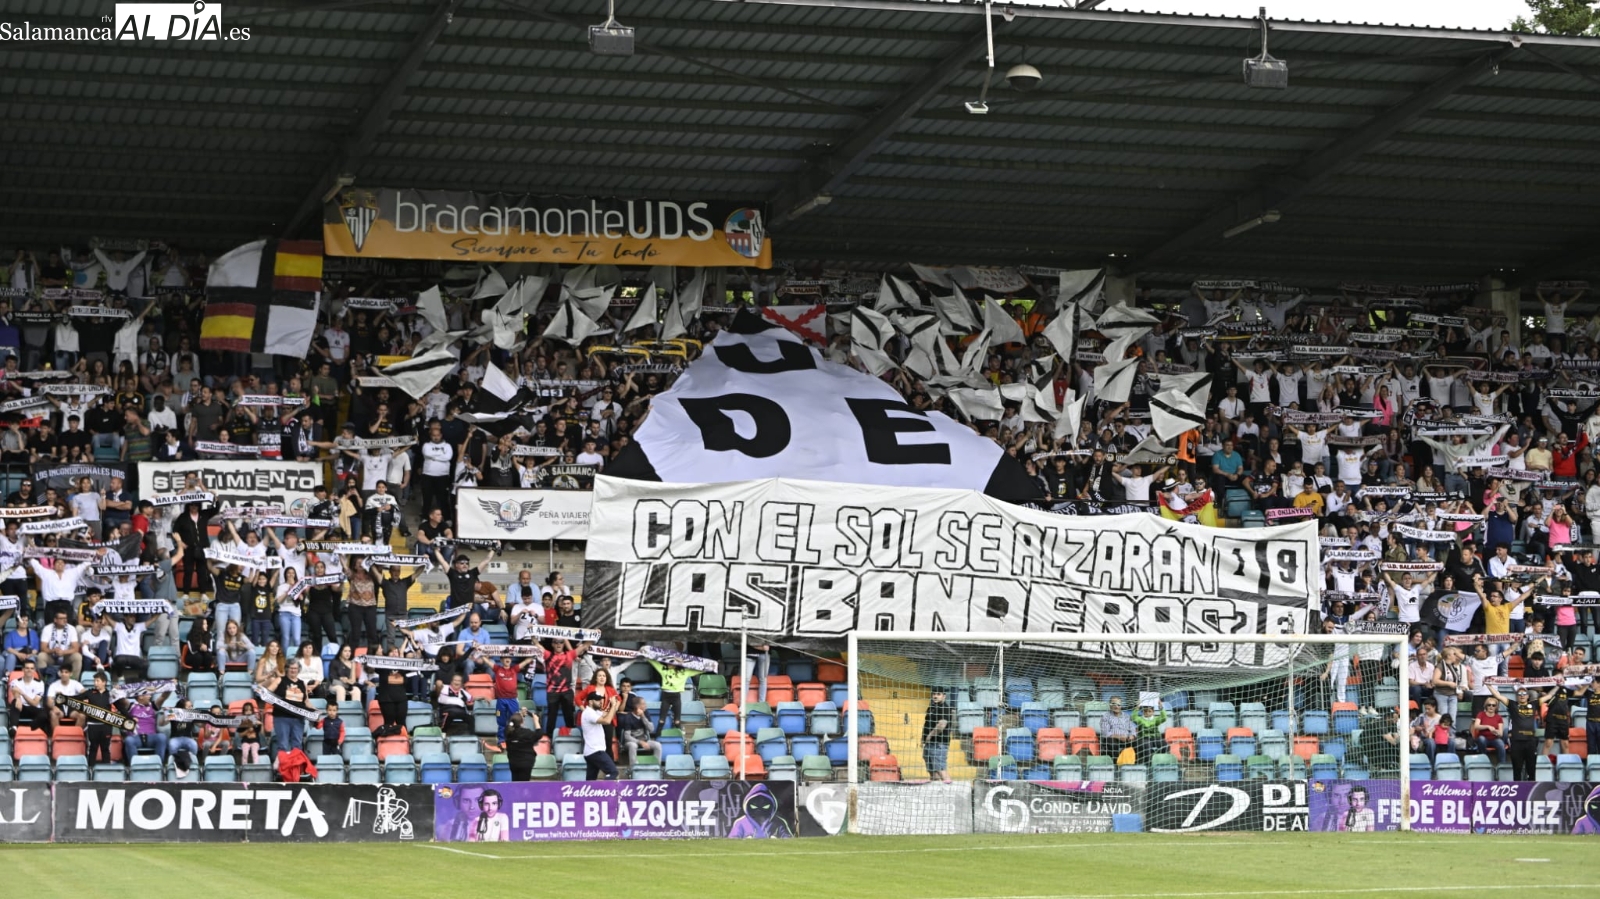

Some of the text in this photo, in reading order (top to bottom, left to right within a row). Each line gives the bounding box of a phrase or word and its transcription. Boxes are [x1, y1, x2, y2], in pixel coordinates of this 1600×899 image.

[395, 192, 714, 242] bracamonteUDS
[451, 237, 541, 258] Siempre
[569, 240, 602, 261] Tu
[613, 243, 661, 261] lado
[714, 340, 817, 374] U
[678, 393, 952, 465] D E
[153, 469, 316, 491] SETIMIENTO
[632, 498, 1216, 595] CON EL SOL SE ALZARÁN
[110, 565, 155, 574] SALAMANCA
[1399, 563, 1436, 571] SALAMANCA
[614, 561, 1237, 669] LAS BANDERAS
[82, 704, 106, 721] YOUNG
[105, 711, 125, 727] BOYS
[560, 783, 669, 798] Hablemos de UDS
[1421, 783, 1519, 798] Hablemos de UDS
[74, 787, 329, 838] MORETA
[512, 800, 576, 829] FEDE
[1030, 797, 1133, 816] CONDE DAVID
[1262, 815, 1287, 831] DE
